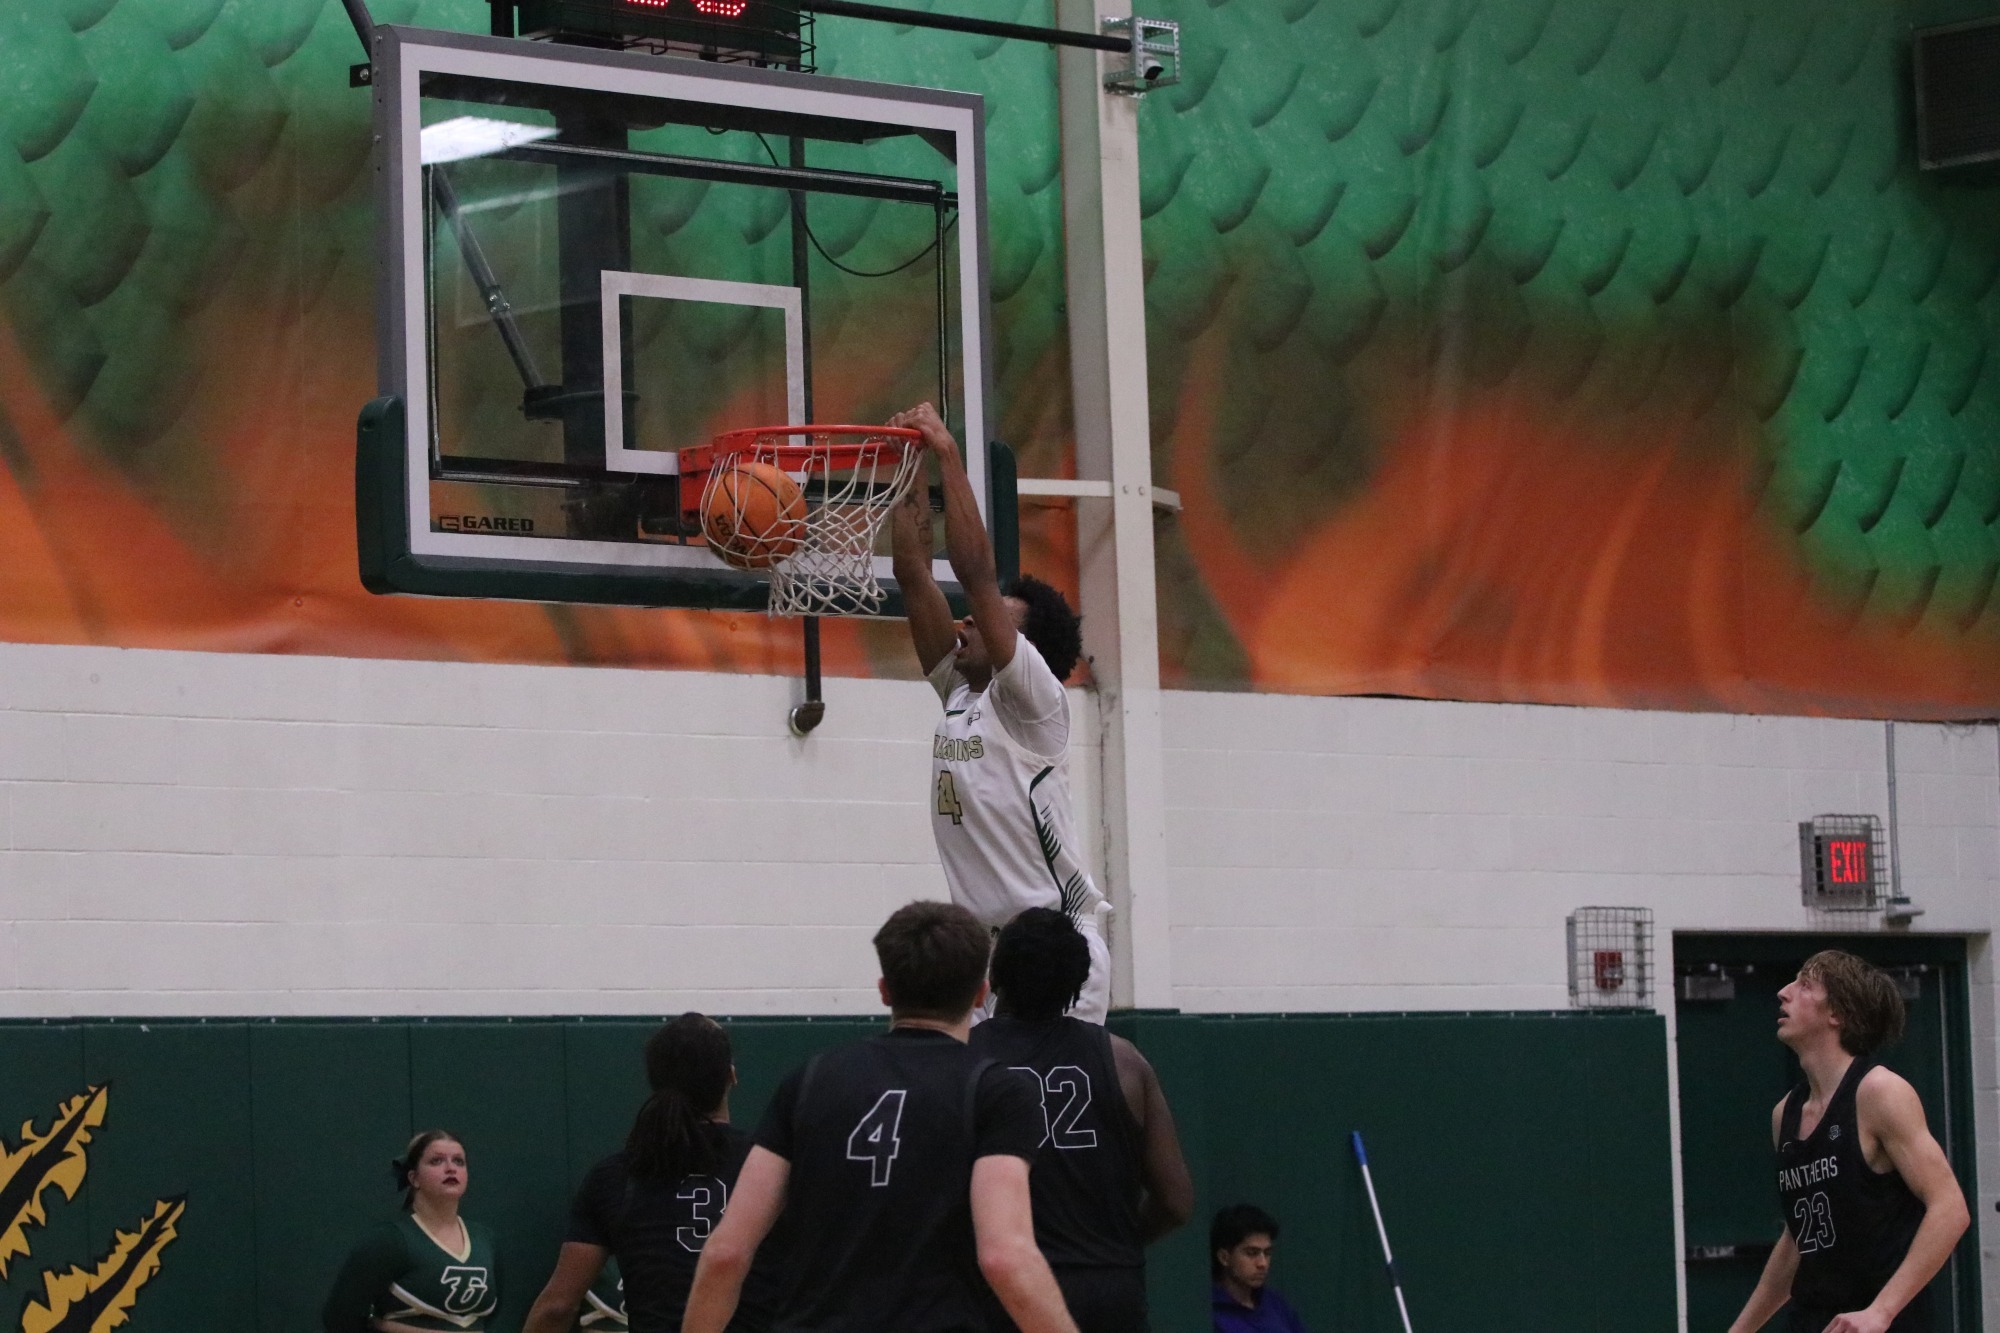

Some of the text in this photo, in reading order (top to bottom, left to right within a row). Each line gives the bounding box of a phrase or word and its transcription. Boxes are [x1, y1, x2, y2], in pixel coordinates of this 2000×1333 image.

[463, 516, 534, 531] GARED
[937, 770, 963, 825] 4
[1829, 841, 1867, 883] EXIT
[847, 1090, 907, 1187] 4
[1779, 1156, 1839, 1192] PANTHERS
[676, 1174, 727, 1252] 3
[1794, 1191, 1836, 1254] 23
